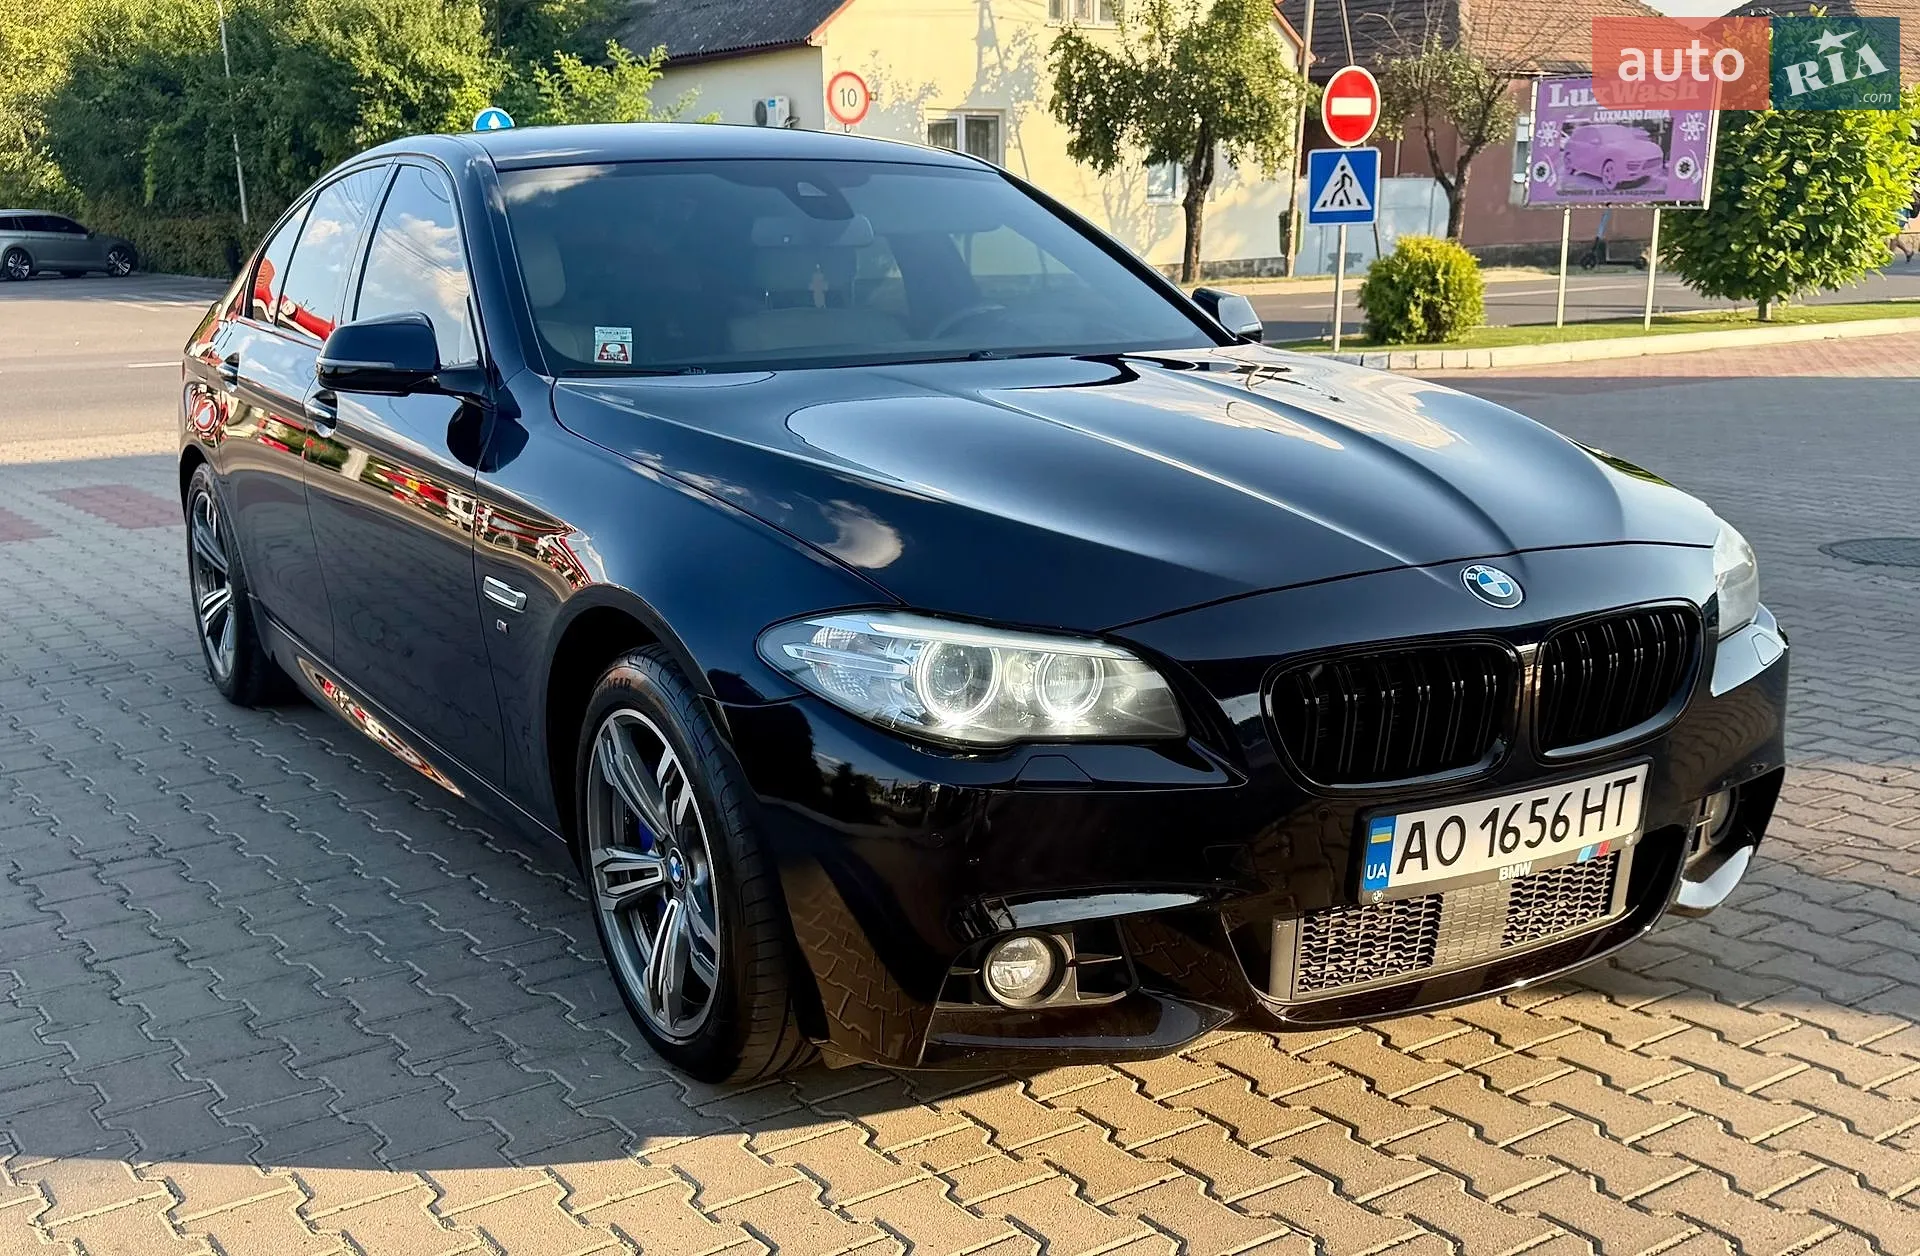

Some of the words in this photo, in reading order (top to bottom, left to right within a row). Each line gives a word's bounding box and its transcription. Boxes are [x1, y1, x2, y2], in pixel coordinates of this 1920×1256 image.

[840, 88, 857, 107] 10
[1396, 815, 1466, 874] AO
[1480, 791, 1573, 858] 1656
[1578, 775, 1638, 837] HT
[1366, 863, 1388, 880] UA
[1499, 861, 1532, 881] BMW
